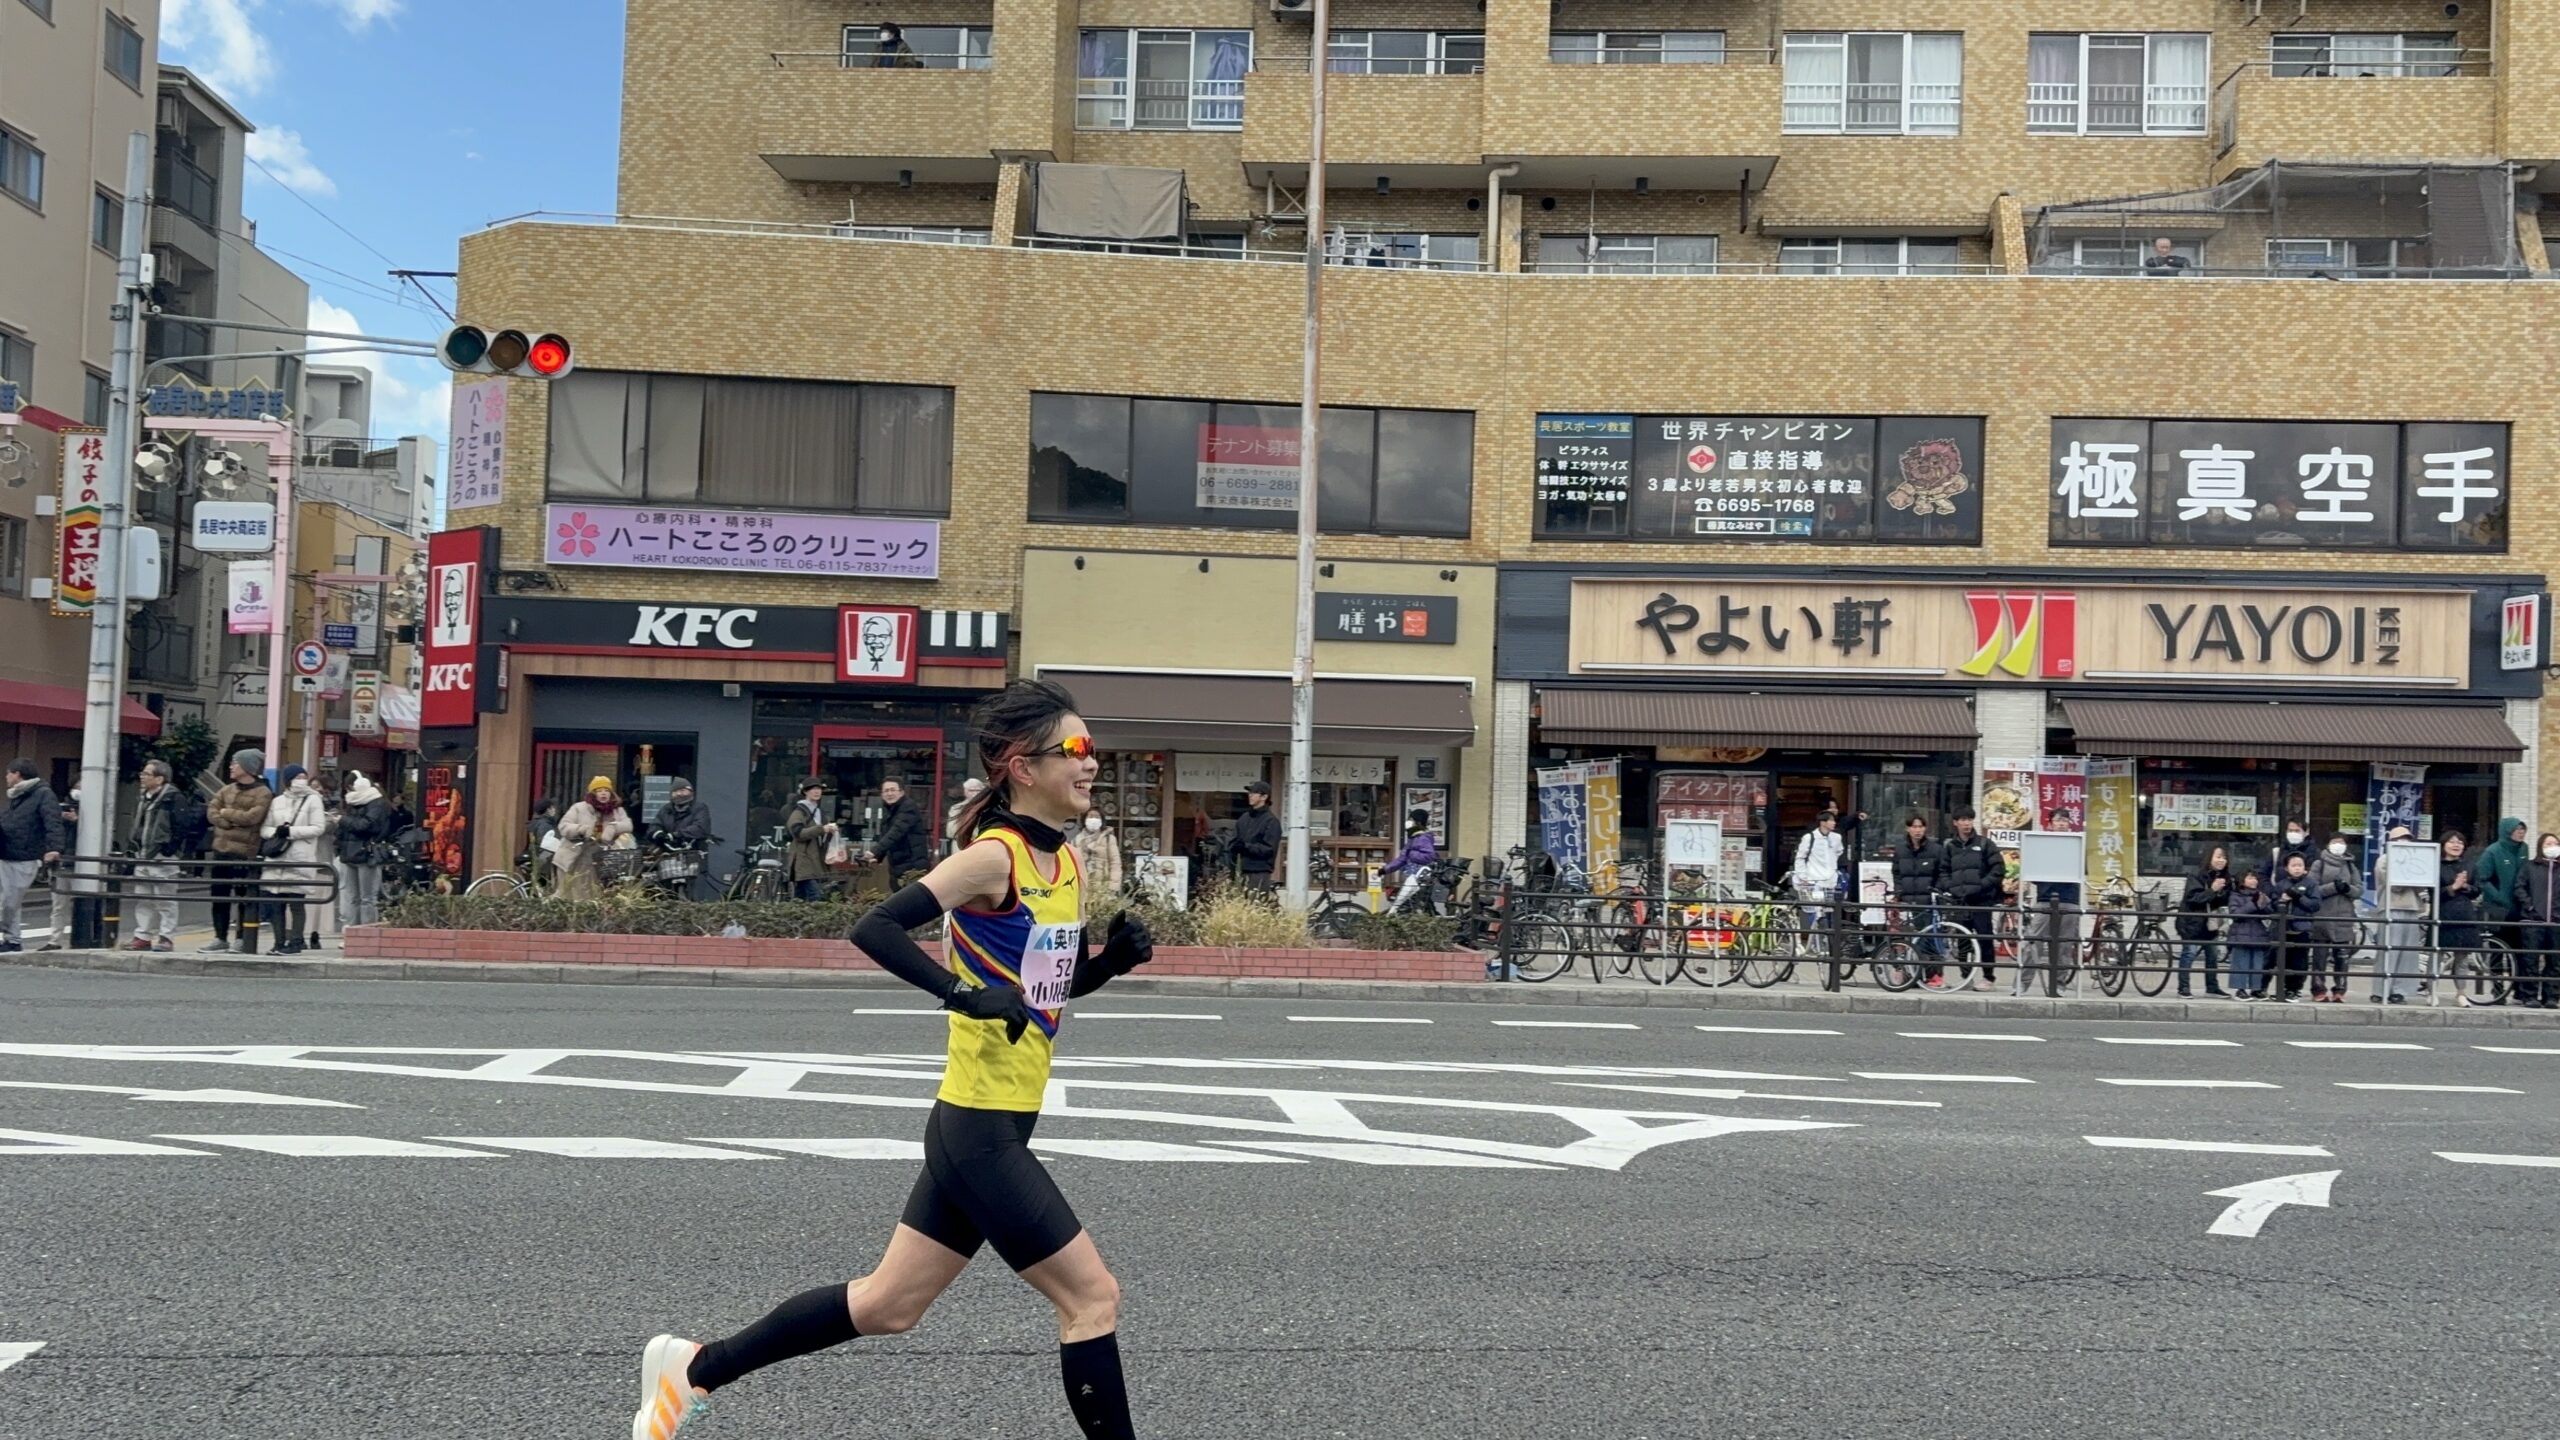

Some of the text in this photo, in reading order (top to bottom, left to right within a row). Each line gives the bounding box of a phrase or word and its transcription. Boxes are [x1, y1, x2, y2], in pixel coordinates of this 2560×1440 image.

[1539, 420, 1631, 433] 長居スポーツ教室
[1661, 420, 1853, 441] 世界チャンピオン
[464, 389, 482, 500] ハートこころの
[1207, 437, 1300, 457] テナント募集
[77, 437, 104, 503] 餃子の
[453, 436, 465, 505] クリニック
[1728, 450, 1824, 471] 直接指導
[1200, 477, 1300, 491] 06-6699-2881
[1647, 478, 1863, 495] 3歳より老若男女初心者歓迎
[2057, 440, 2500, 523] 極真空手
[199, 519, 268, 536] 長居中央商店街
[67, 526, 99, 587] 王将
[608, 527, 929, 560] ハートこころのクリニック
[632, 553, 667, 564] HEART
[671, 555, 729, 567] KOKORONO
[731, 557, 769, 568] CLINIC
[628, 605, 758, 648] KFC
[1338, 608, 1398, 634] 膳や
[1636, 592, 1893, 655] やよい軒
[2146, 603, 2401, 665] YAYOI KEN
[426, 663, 473, 692] KFC
[1311, 766, 1379, 779] べんとう
[1055, 958, 1073, 978] 52
